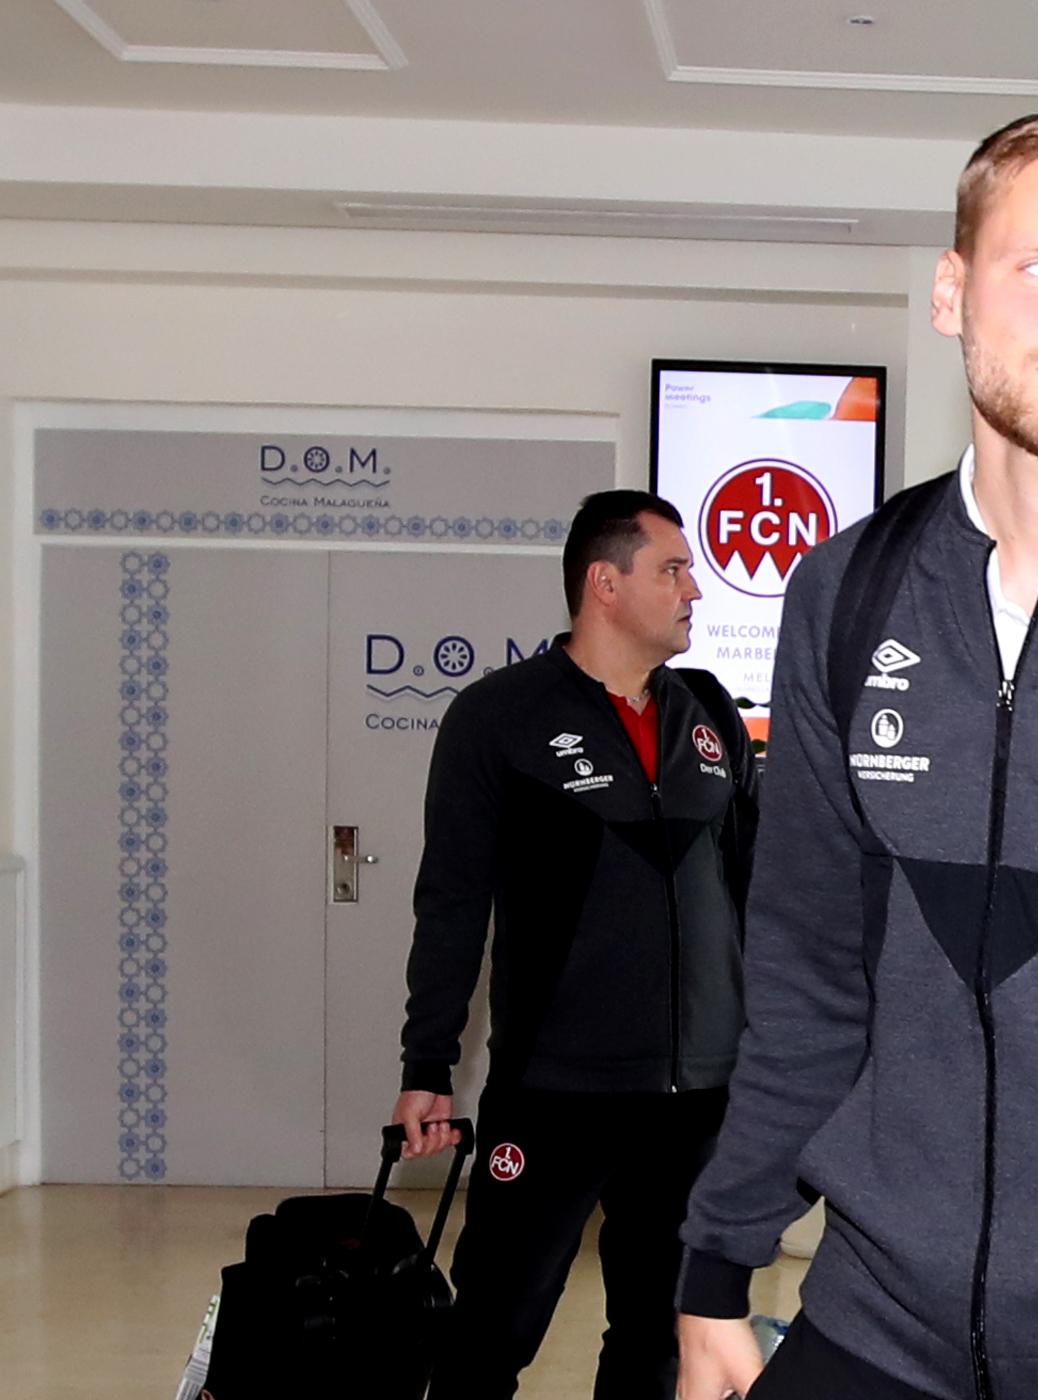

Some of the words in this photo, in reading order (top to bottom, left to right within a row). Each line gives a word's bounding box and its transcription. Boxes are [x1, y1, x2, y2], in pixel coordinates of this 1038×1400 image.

[755, 471, 783, 507] 1.
[718, 509, 817, 547] FCN
[716, 646, 776, 661] MARBE
[365, 713, 440, 730] COCINA
